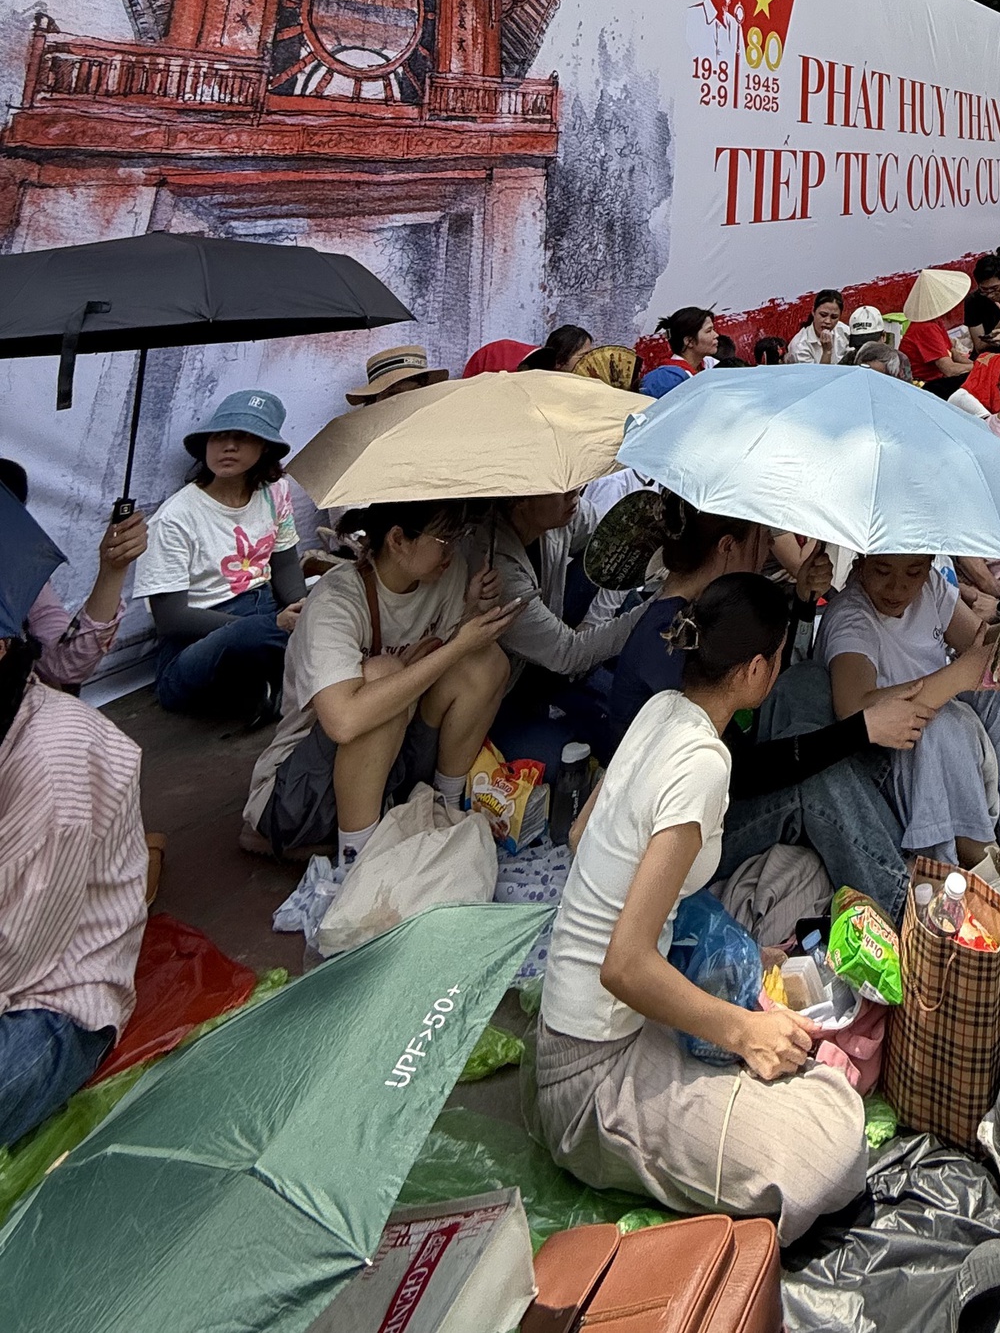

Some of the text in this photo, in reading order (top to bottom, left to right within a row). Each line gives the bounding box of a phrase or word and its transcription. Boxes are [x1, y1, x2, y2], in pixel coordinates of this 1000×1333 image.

[746, 26, 783, 72] 80
[692, 56, 729, 83] 19-8
[700, 83, 728, 108] 2-9
[745, 73, 780, 94] 1945
[797, 54, 891, 131] PHÁT
[897, 76, 950, 137] HUY
[744, 92, 780, 113] 2025
[714, 135, 826, 227] TIẾP
[835, 151, 899, 220] TỤC
[906, 149, 971, 212] CÔNG
